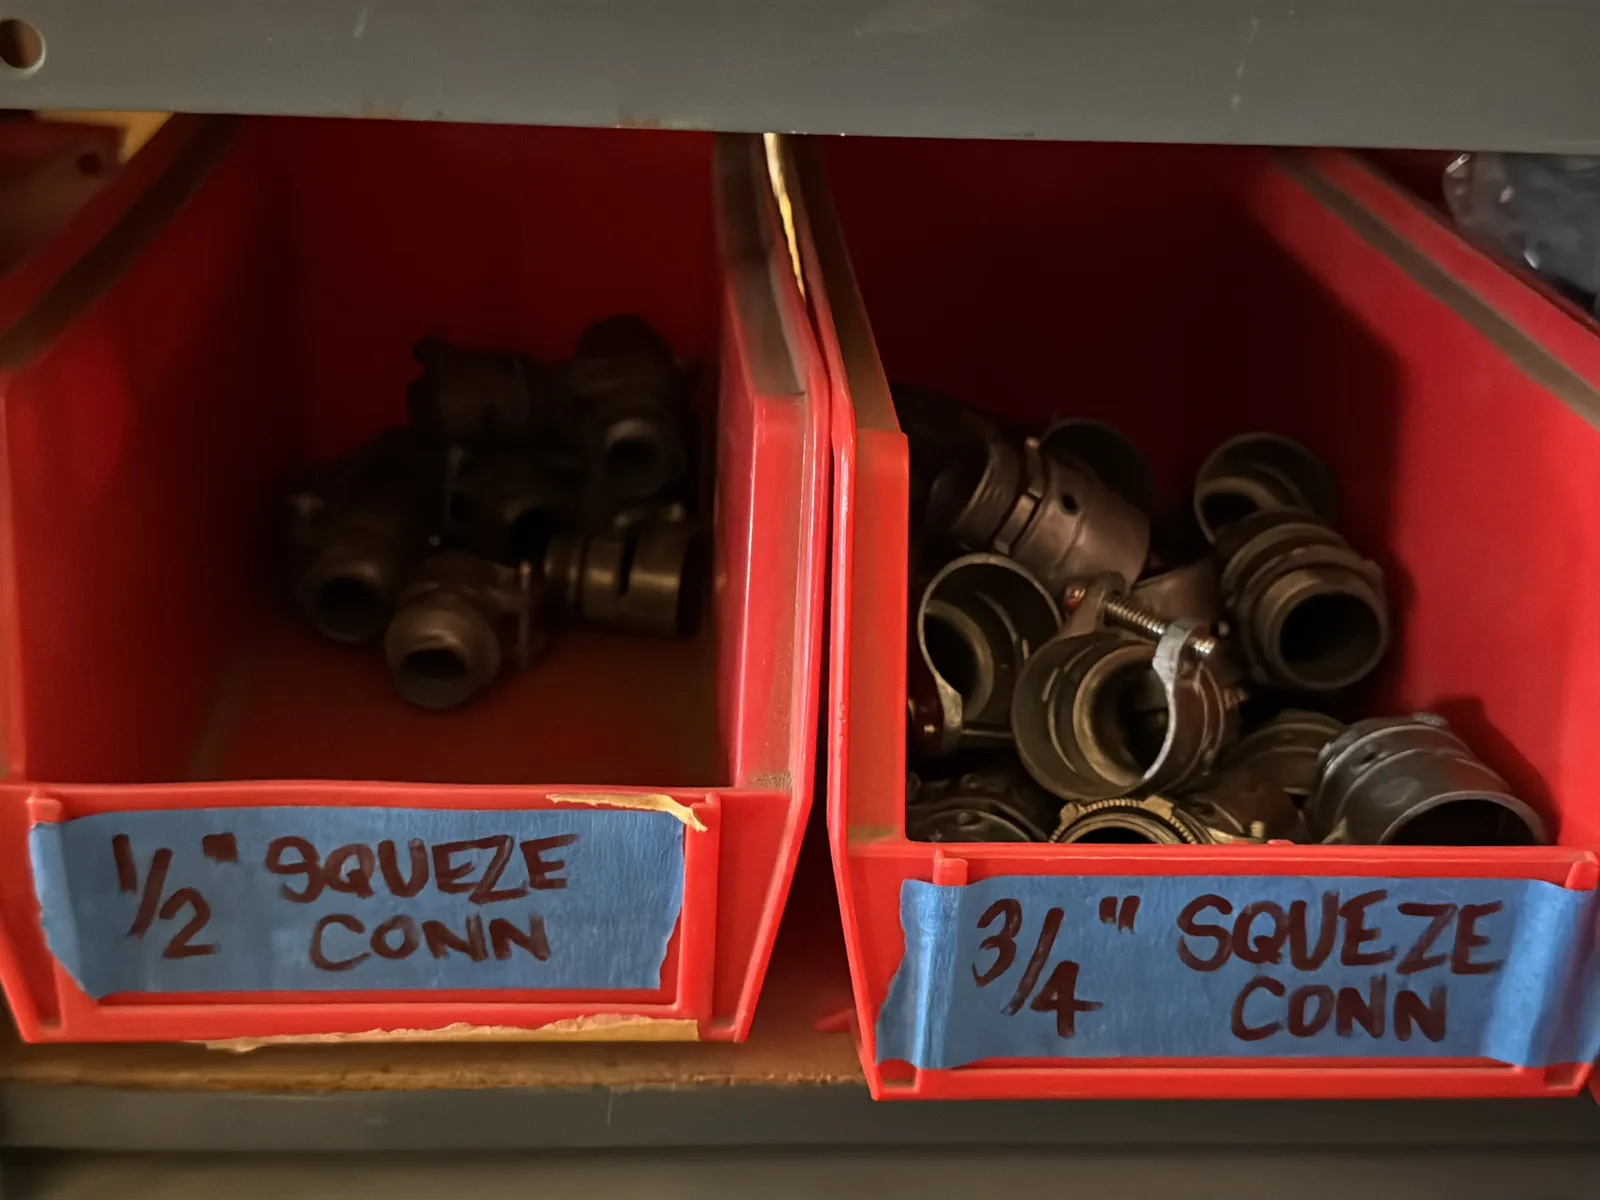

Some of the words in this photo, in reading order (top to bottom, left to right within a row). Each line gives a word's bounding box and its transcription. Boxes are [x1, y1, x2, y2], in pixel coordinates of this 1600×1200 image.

[265, 833, 580, 904] SQUEZE
[309, 912, 551, 972] CONN
[1176, 889, 1505, 975] SQUEZE
[1230, 974, 1447, 1043] CONN
